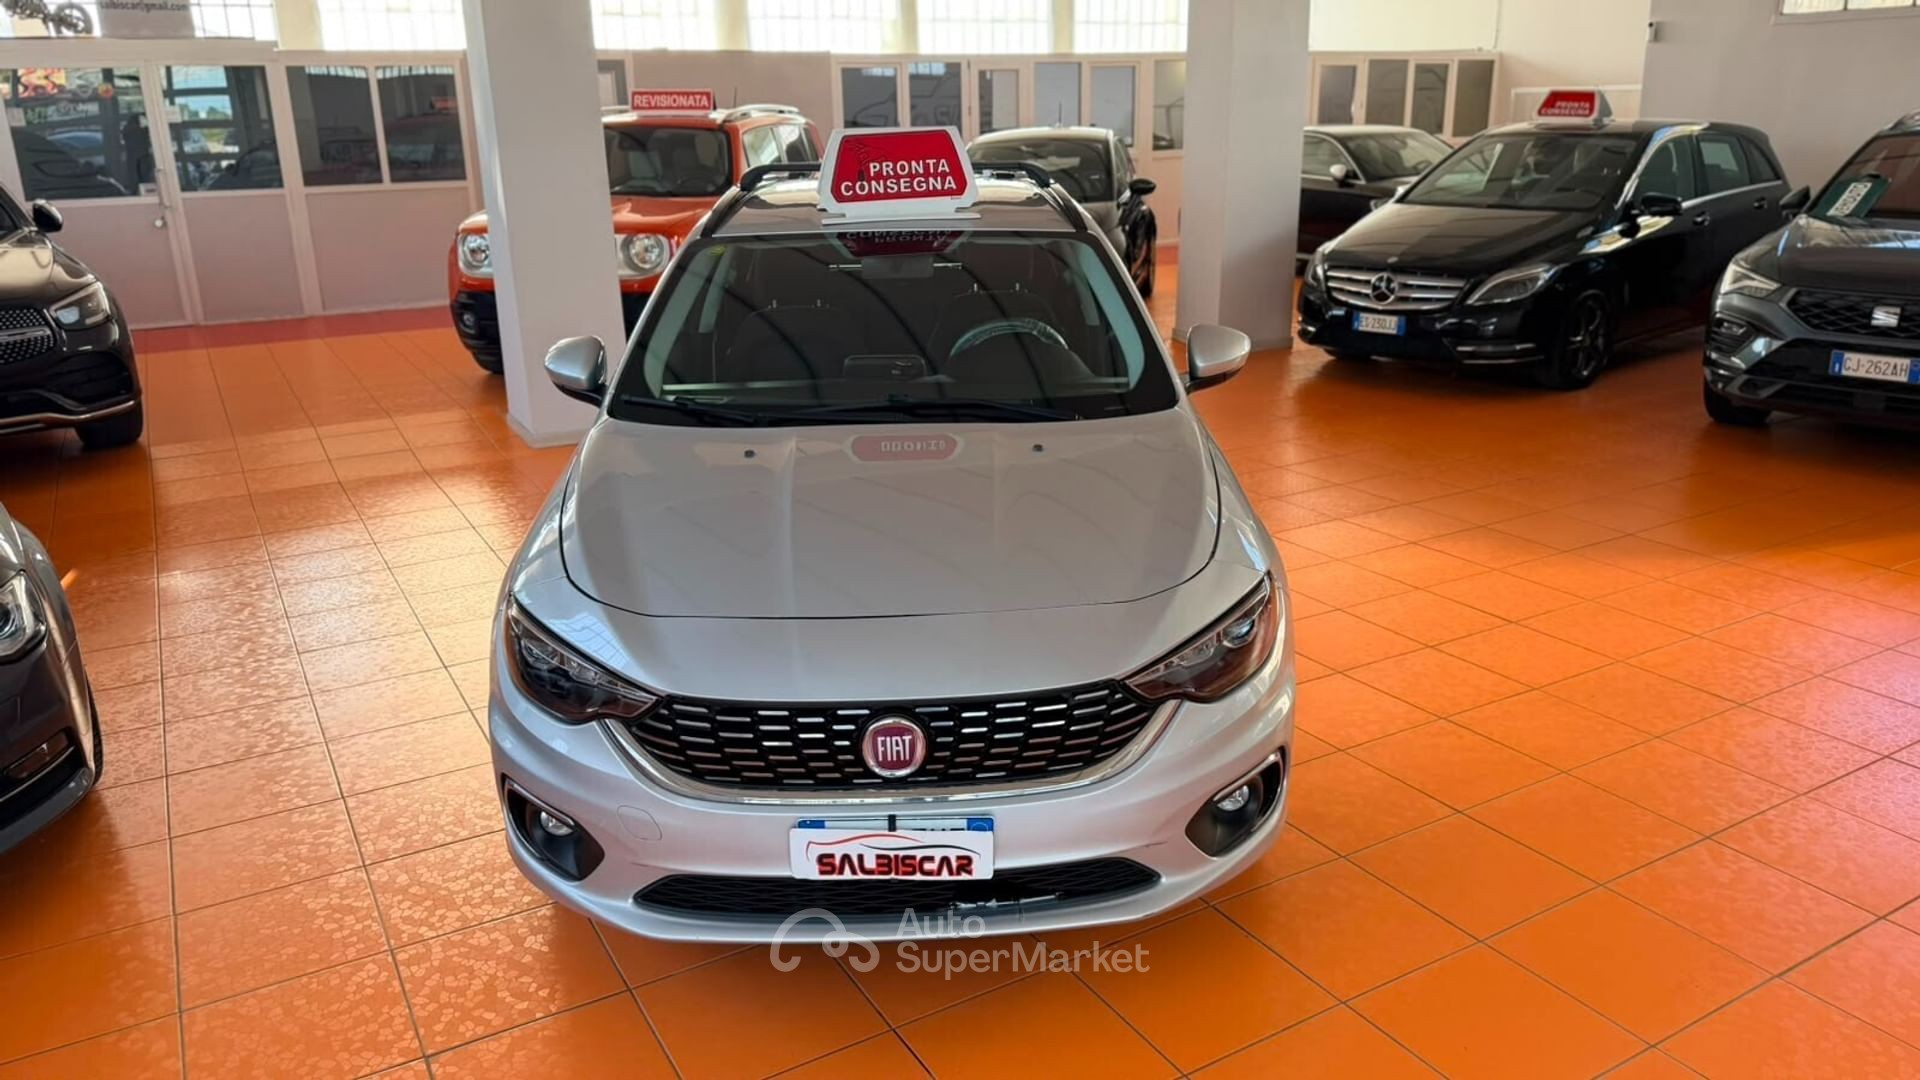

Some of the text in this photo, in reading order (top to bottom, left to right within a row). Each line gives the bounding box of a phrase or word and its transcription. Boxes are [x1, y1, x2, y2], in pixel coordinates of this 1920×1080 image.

[634, 94, 709, 107] REVISIONATA
[869, 159, 950, 177] PRONTA
[840, 176, 957, 196] CONSEGNA
[877, 735, 913, 762] FIAT
[816, 853, 974, 876] SALBISCAR
